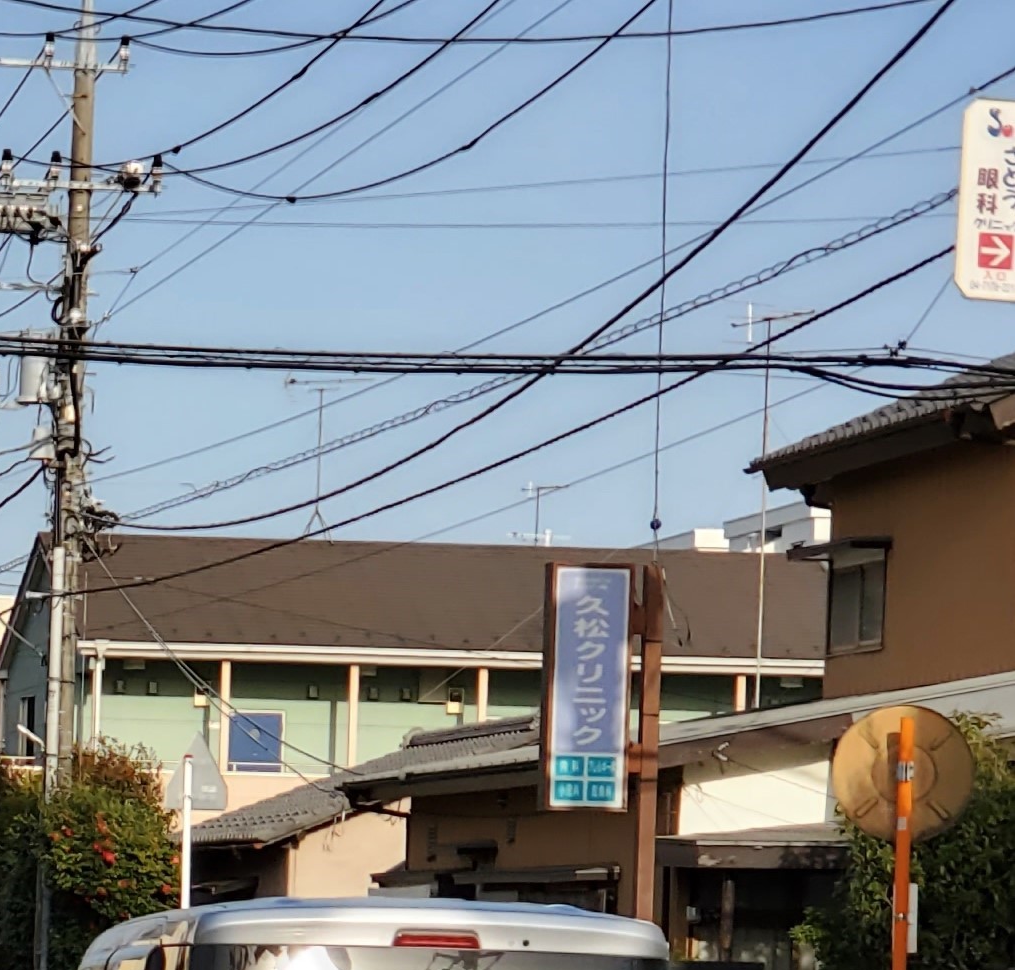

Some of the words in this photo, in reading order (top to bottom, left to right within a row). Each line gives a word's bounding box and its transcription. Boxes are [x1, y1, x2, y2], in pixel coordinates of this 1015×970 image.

[975, 167, 999, 215] 眼科
[973, 218, 1015, 232] クリニッ
[572, 595, 610, 746] 久松クリニック
